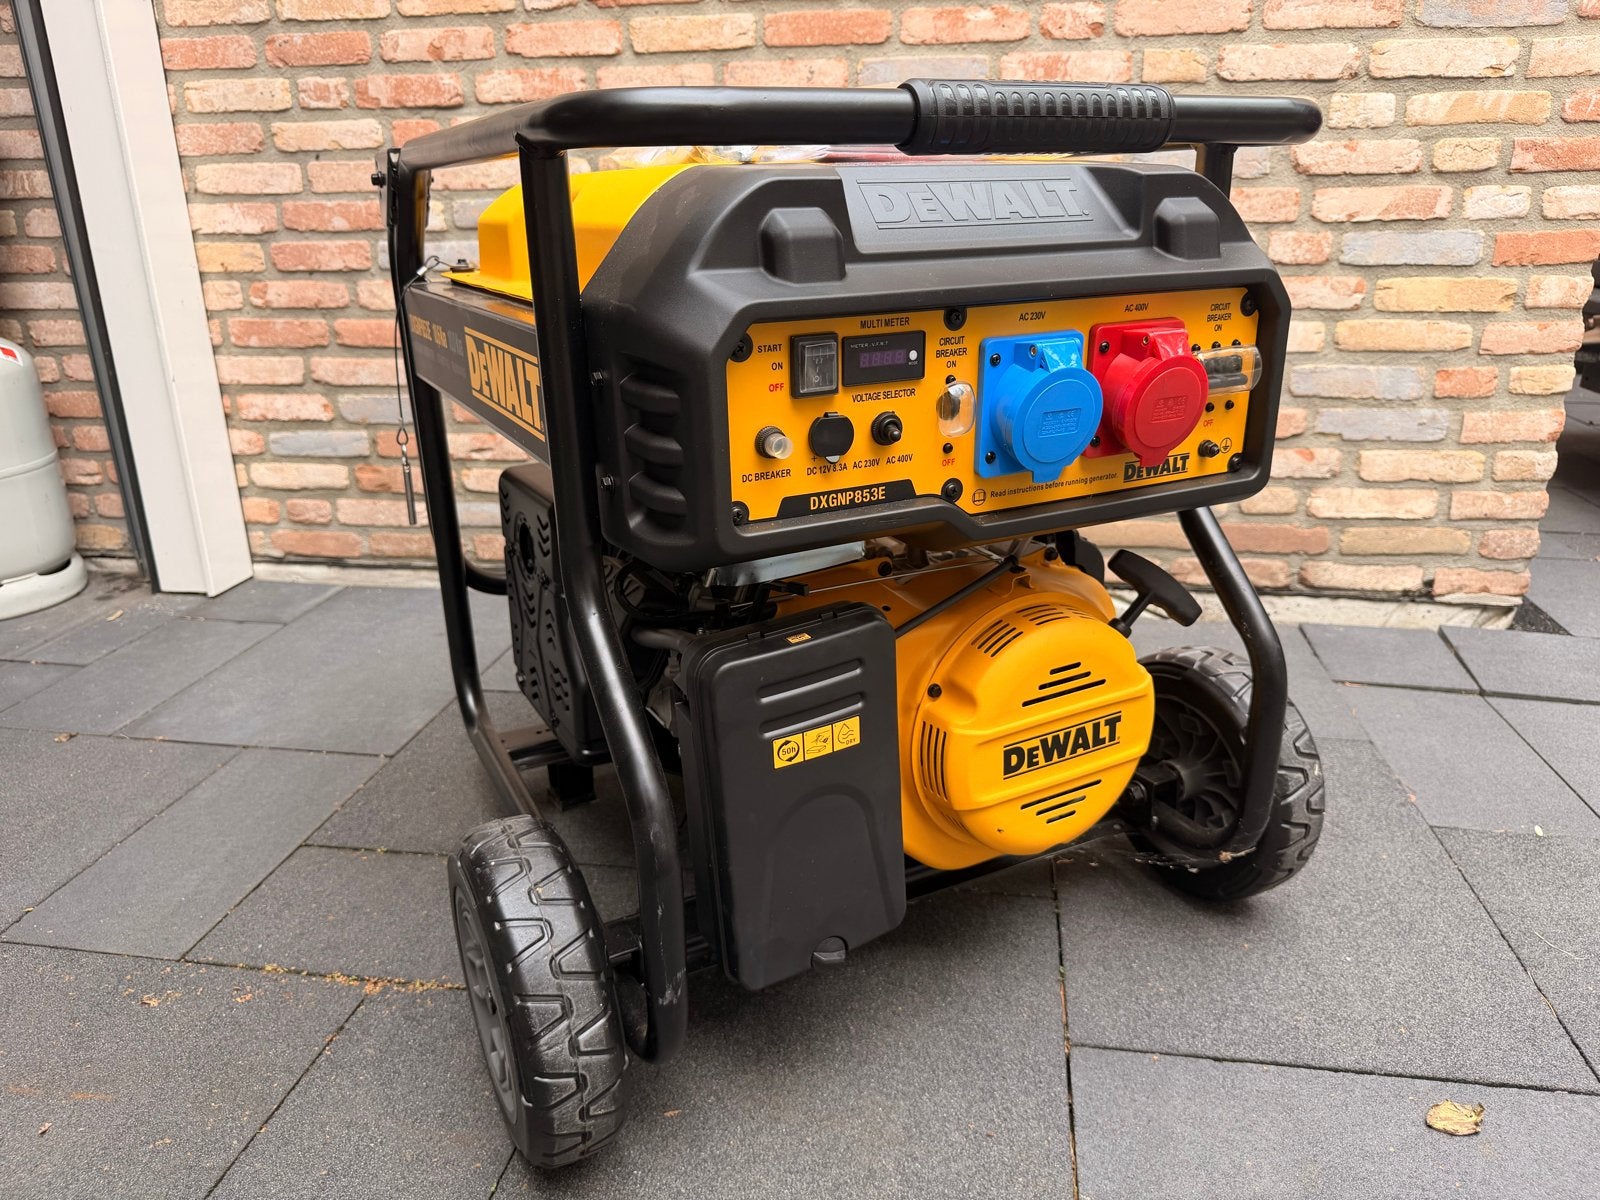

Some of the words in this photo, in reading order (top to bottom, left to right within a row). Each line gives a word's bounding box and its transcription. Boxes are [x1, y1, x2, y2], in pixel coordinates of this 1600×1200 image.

[859, 181, 1084, 223] DEWALT
[1124, 304, 1135, 312] AC
[1135, 303, 1149, 312] 400V
[1210, 303, 1231, 312] CIRCUIT
[1018, 312, 1030, 322] AC
[1030, 311, 1046, 321] 230V
[1207, 313, 1232, 322] BREAKER
[860, 318, 883, 329] MULTI
[884, 317, 910, 327] METER
[1214, 324, 1222, 332] ON
[939, 336, 965, 346] CIRCUIT
[757, 344, 783, 354] START
[935, 348, 967, 358] BREAKER
[771, 362, 783, 370] ON
[946, 360, 957, 368] ON
[465, 334, 541, 430] DEWALT
[768, 383, 784, 392] OFF
[852, 392, 881, 403] VOLTAGE
[882, 388, 916, 400] SELECTOR
[1203, 419, 1214, 428] OFF
[852, 460, 862, 469] AC
[864, 458, 880, 468] 230V
[886, 456, 896, 465] AC
[897, 454, 913, 464] 400V
[942, 458, 956, 467] OFF
[806, 467, 817, 476] DC
[819, 465, 831, 474] 12V
[832, 463, 848, 473] 8.3A
[741, 473, 753, 483] DC
[754, 469, 791, 482] BREAKER
[990, 490, 1006, 498] Read
[1007, 485, 1044, 496] instructions
[1045, 481, 1064, 490] before
[1065, 477, 1088, 487] running
[1089, 473, 1119, 484] generator.
[810, 486, 886, 511] DXGNP853E
[846, 738, 856, 746] DRY
[1003, 715, 1121, 776] DEWALT
[781, 746, 796, 756] 50h
